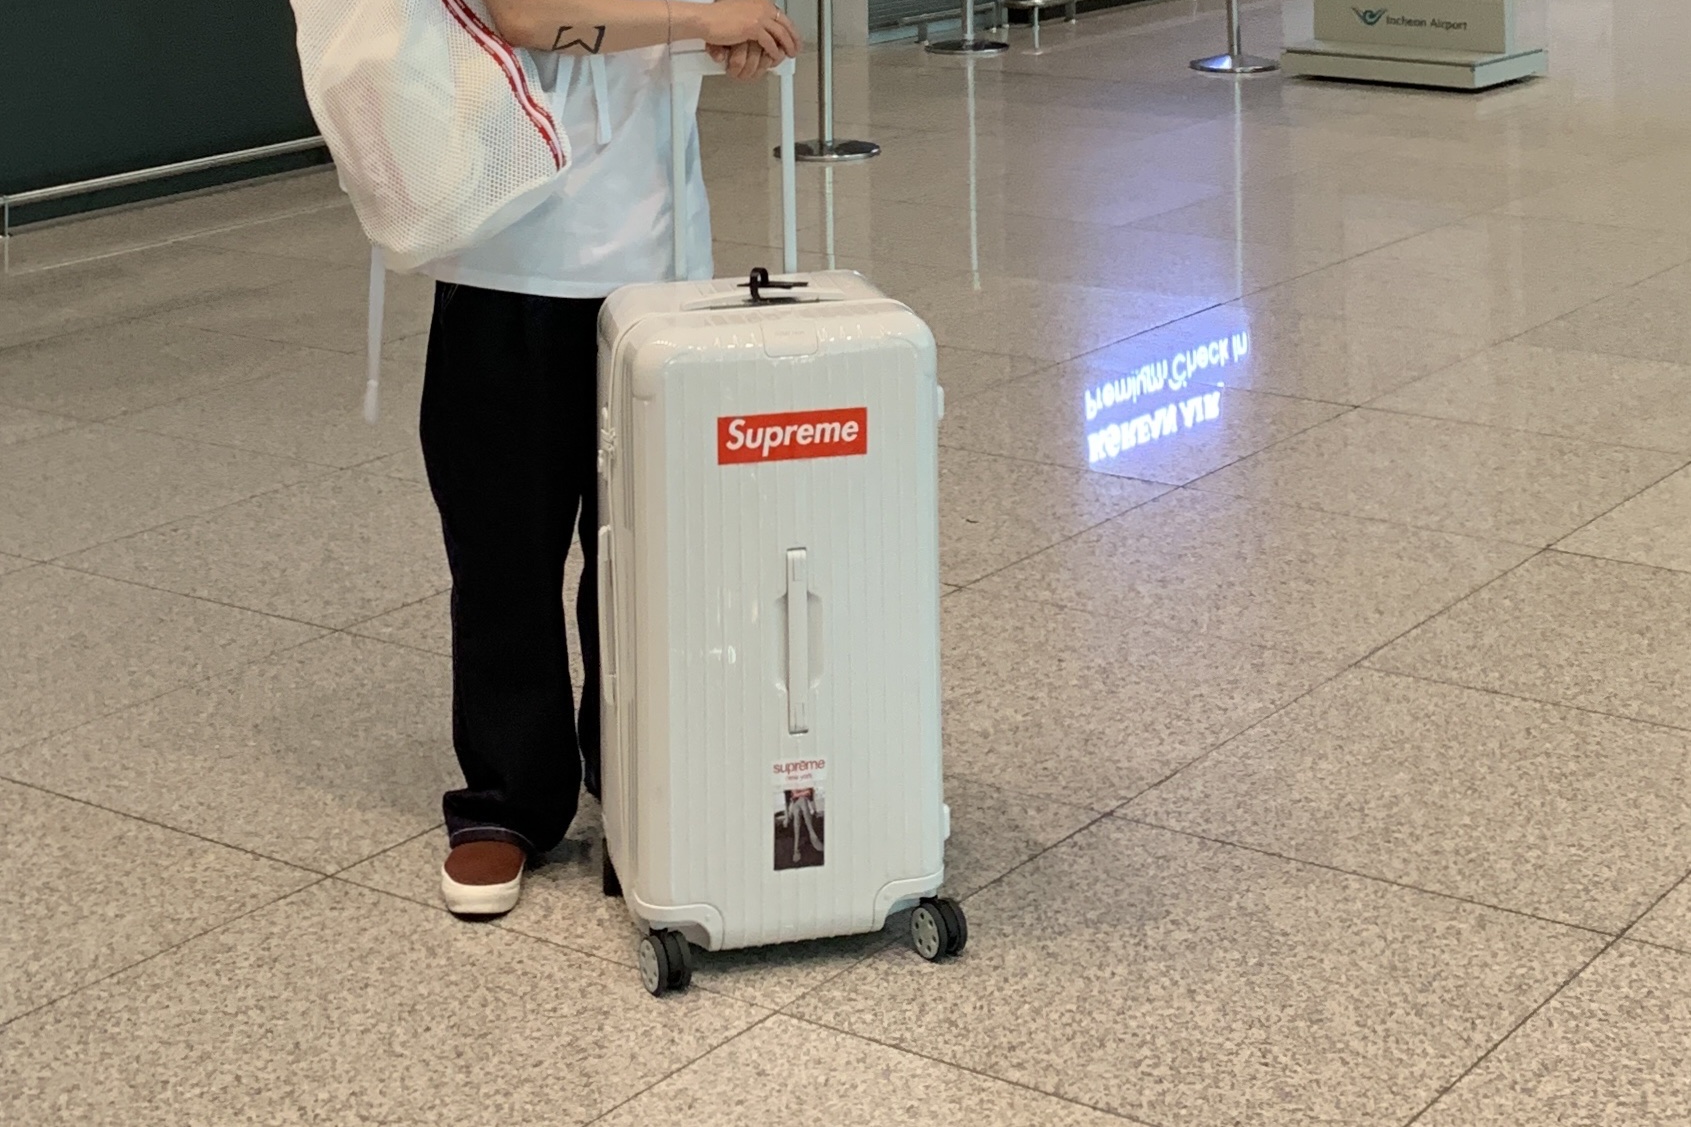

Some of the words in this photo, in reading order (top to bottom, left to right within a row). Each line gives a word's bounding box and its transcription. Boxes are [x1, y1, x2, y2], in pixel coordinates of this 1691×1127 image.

[1386, 16, 1427, 27] Incheon
[1430, 18, 1468, 31] Airport
[726, 419, 859, 457] Supreme
